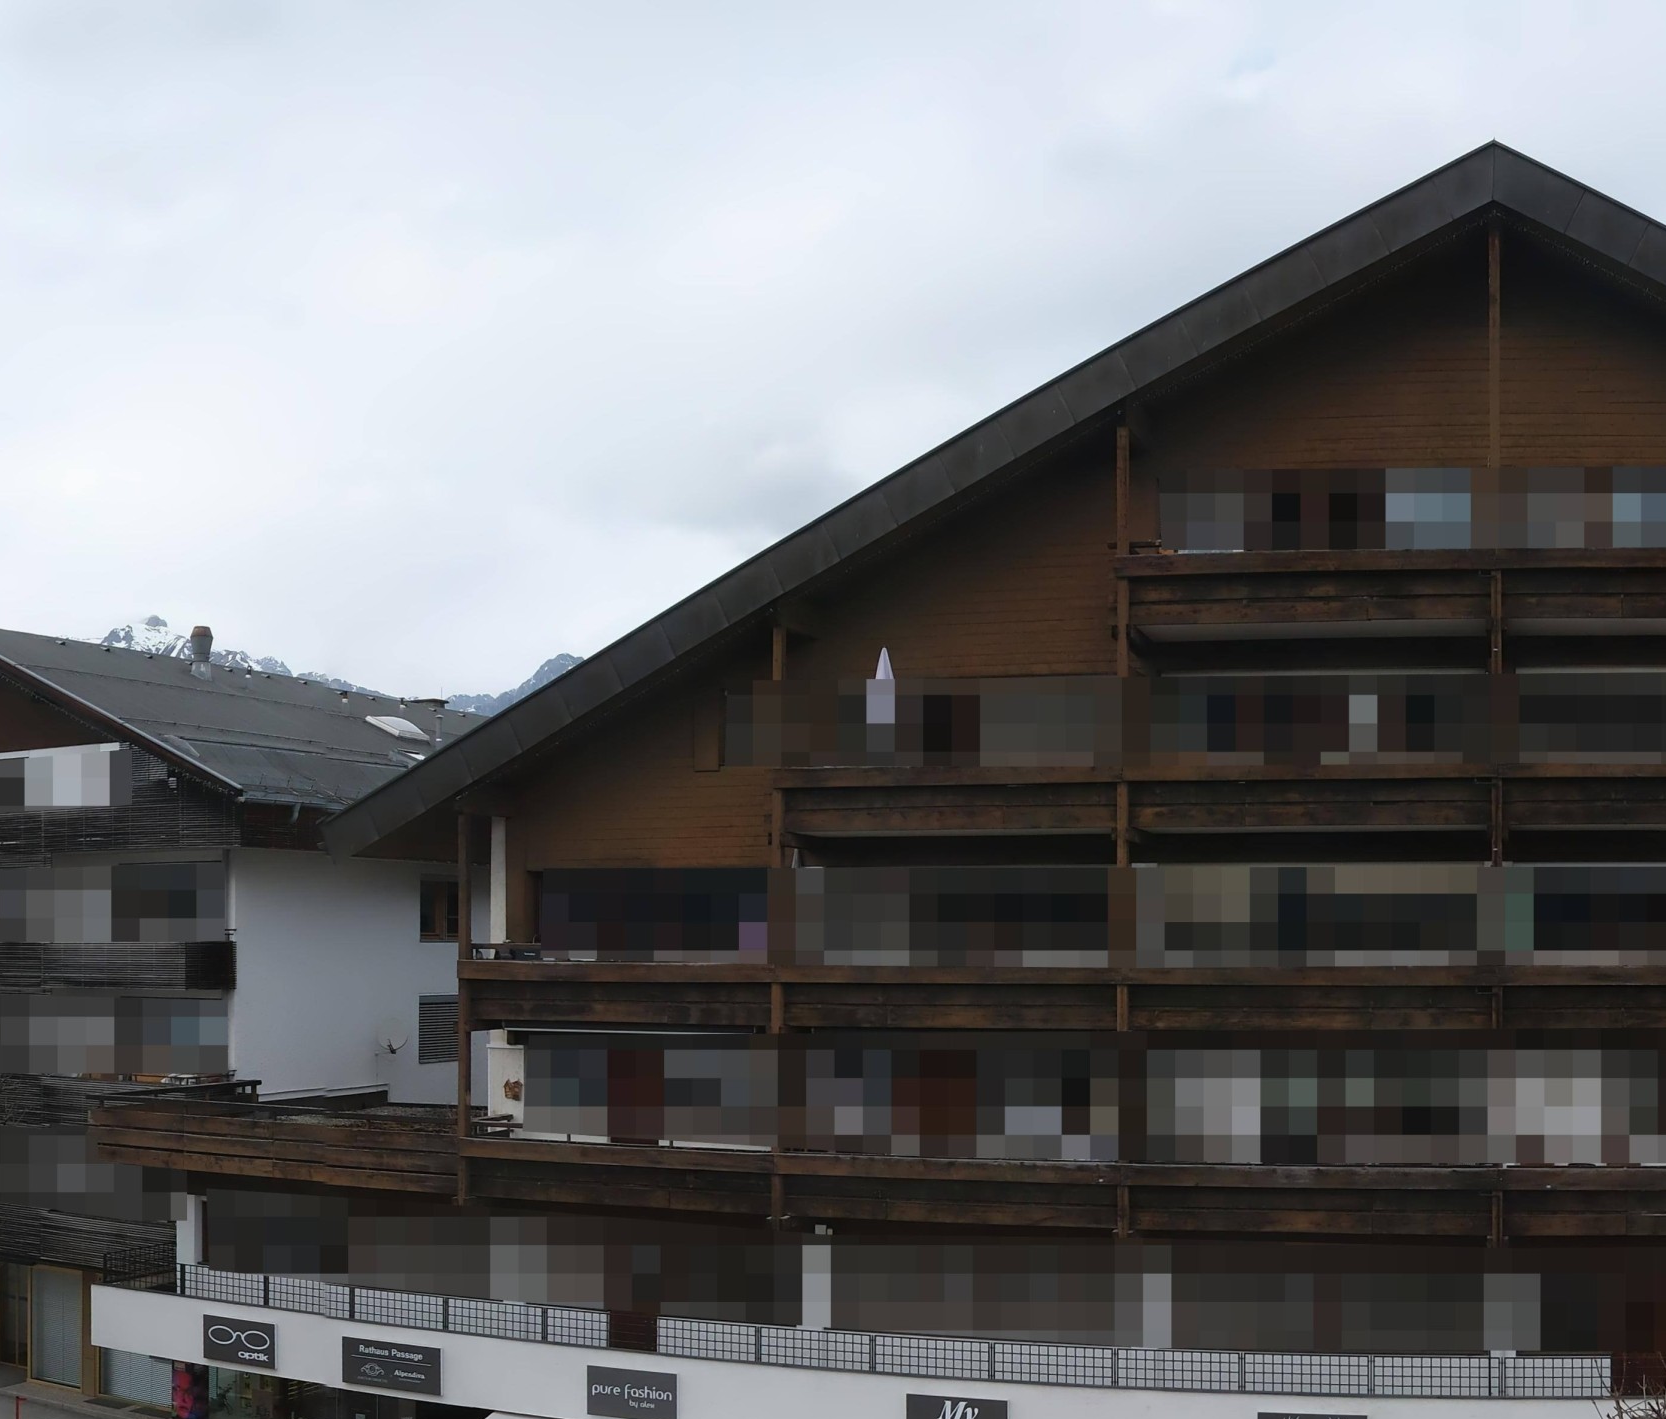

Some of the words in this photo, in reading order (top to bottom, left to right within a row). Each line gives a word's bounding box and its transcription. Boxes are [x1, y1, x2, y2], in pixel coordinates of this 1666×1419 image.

[238, 1350, 270, 1362] optik
[359, 1344, 389, 1356] Rathaus
[391, 1348, 423, 1361] Passage
[592, 1384, 621, 1396] pure
[624, 1383, 673, 1401] fashion
[629, 1400, 638, 1409] by
